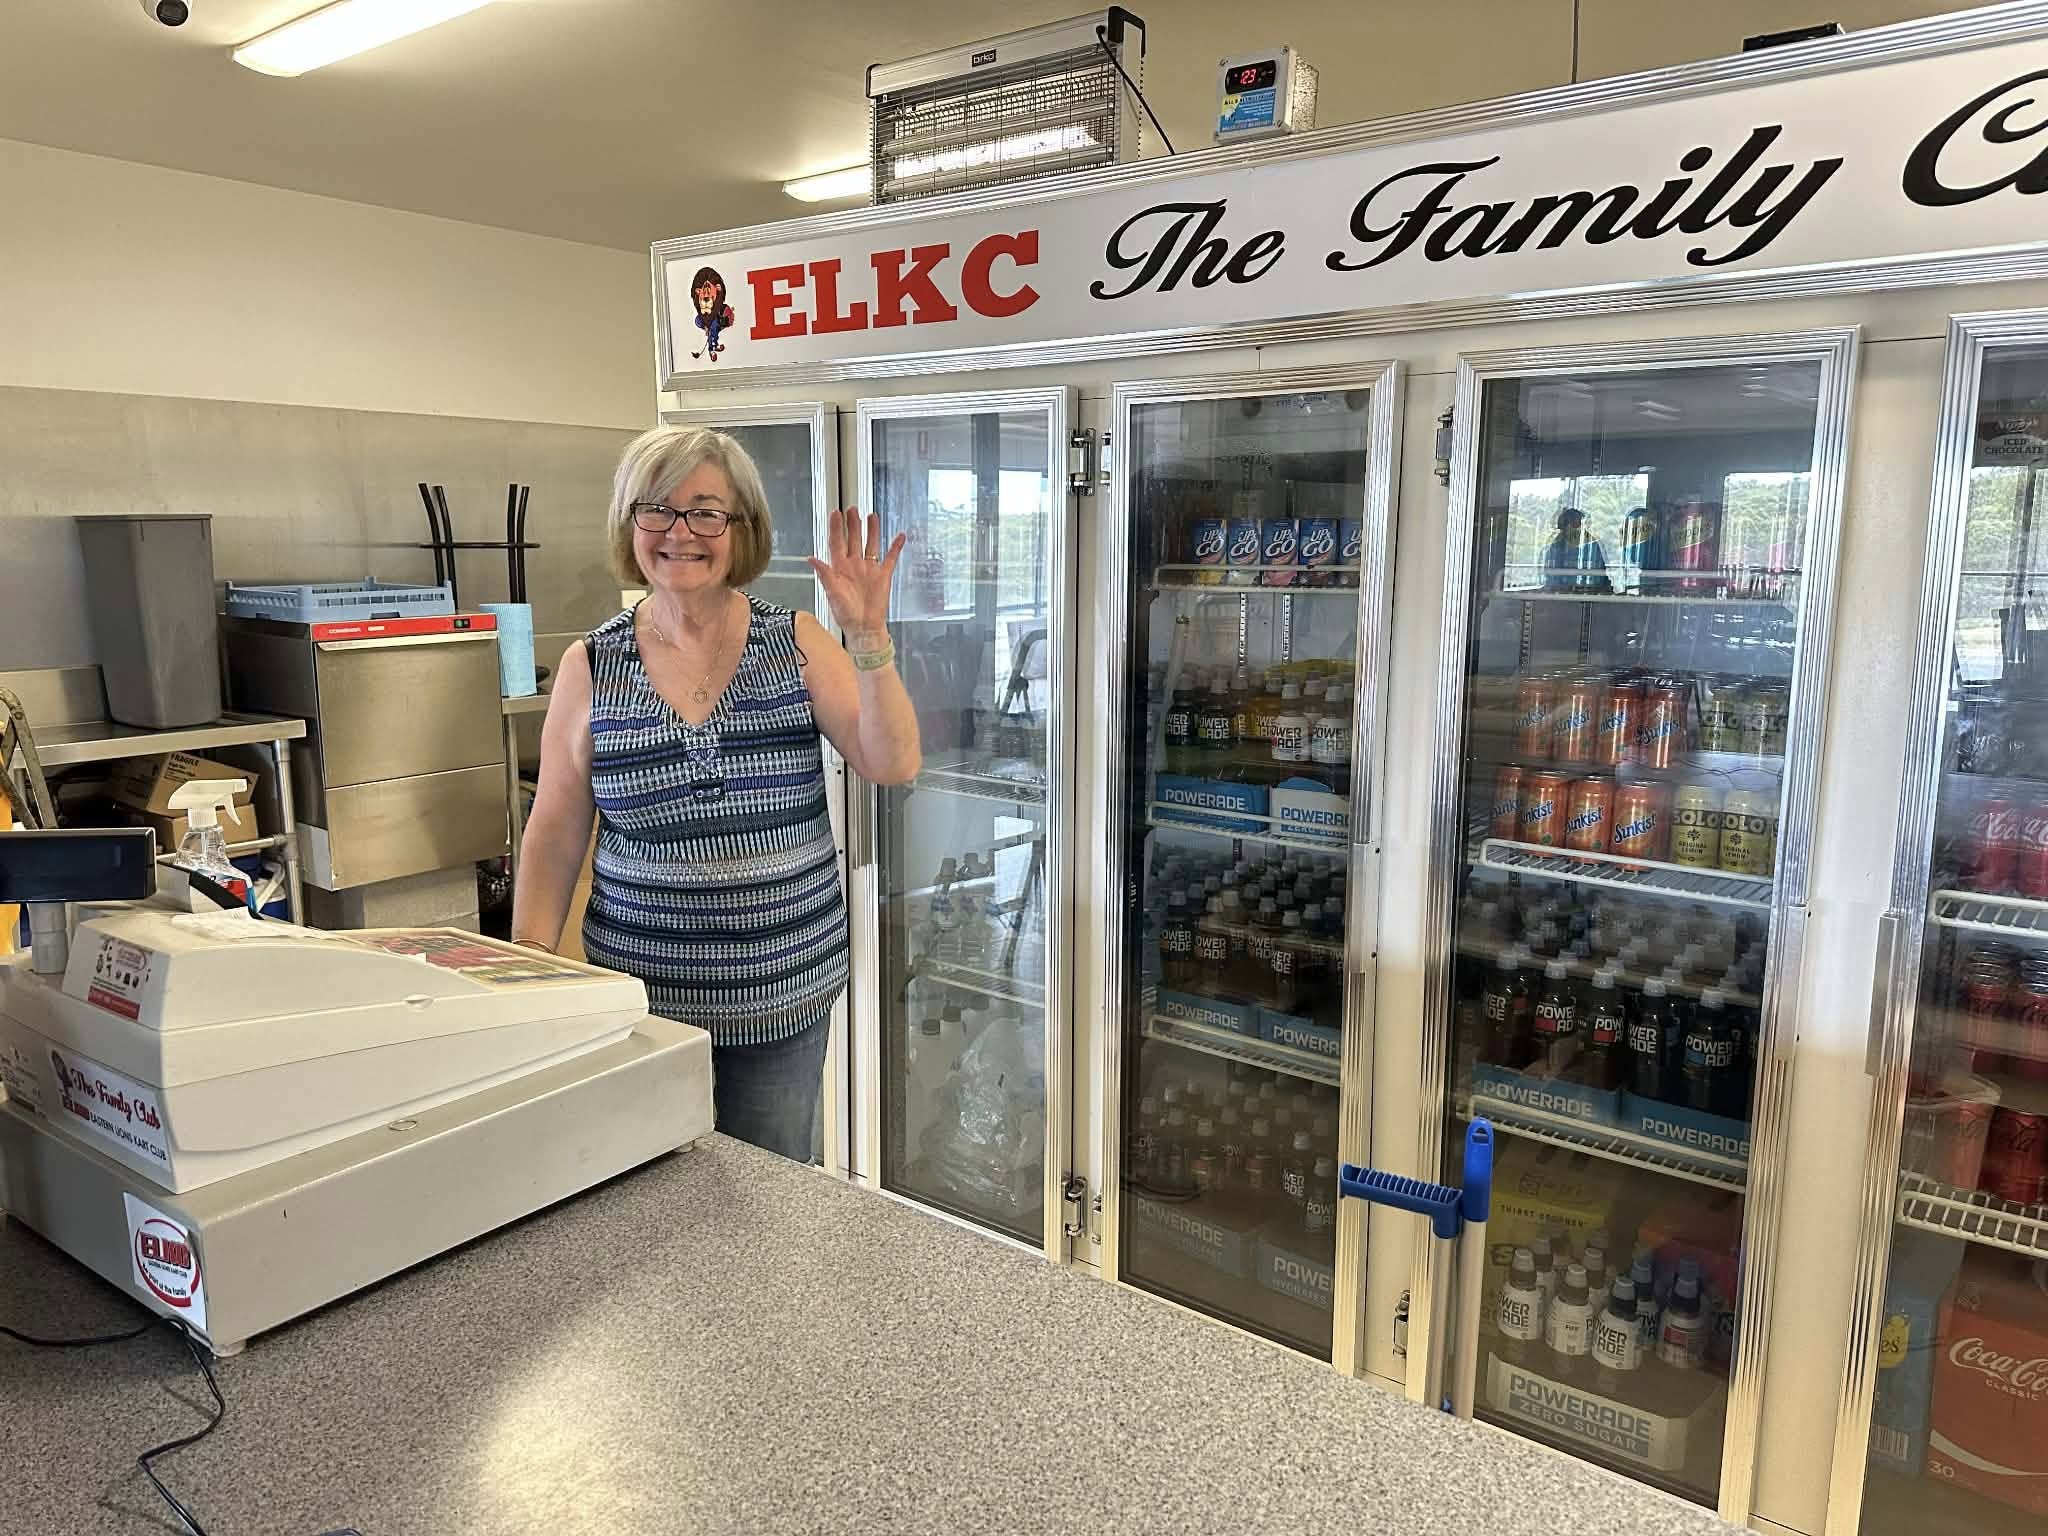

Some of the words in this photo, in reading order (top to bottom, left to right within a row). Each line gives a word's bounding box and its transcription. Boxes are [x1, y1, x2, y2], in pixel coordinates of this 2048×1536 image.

[747, 230, 1040, 340] ELKC
[1089, 198, 1285, 300] The
[1325, 124, 1844, 272] Family
[1902, 68, 2048, 207] C
[1165, 788, 1246, 811] POWERADE
[1281, 807, 1349, 826] POWERA
[1614, 812, 1656, 844] Sunkist
[1166, 1001, 1241, 1030] POWERADE
[1273, 1024, 1340, 1057] POWERA
[1482, 1078, 1593, 1118] POWERADE
[1950, 1337, 2048, 1392] Coca-Co
[1509, 1373, 1651, 1440] POWERADE
[1519, 1399, 1566, 1425] ZERO
[1575, 1418, 1639, 1450] SUGAR
[1929, 1460, 1955, 1478] 30
